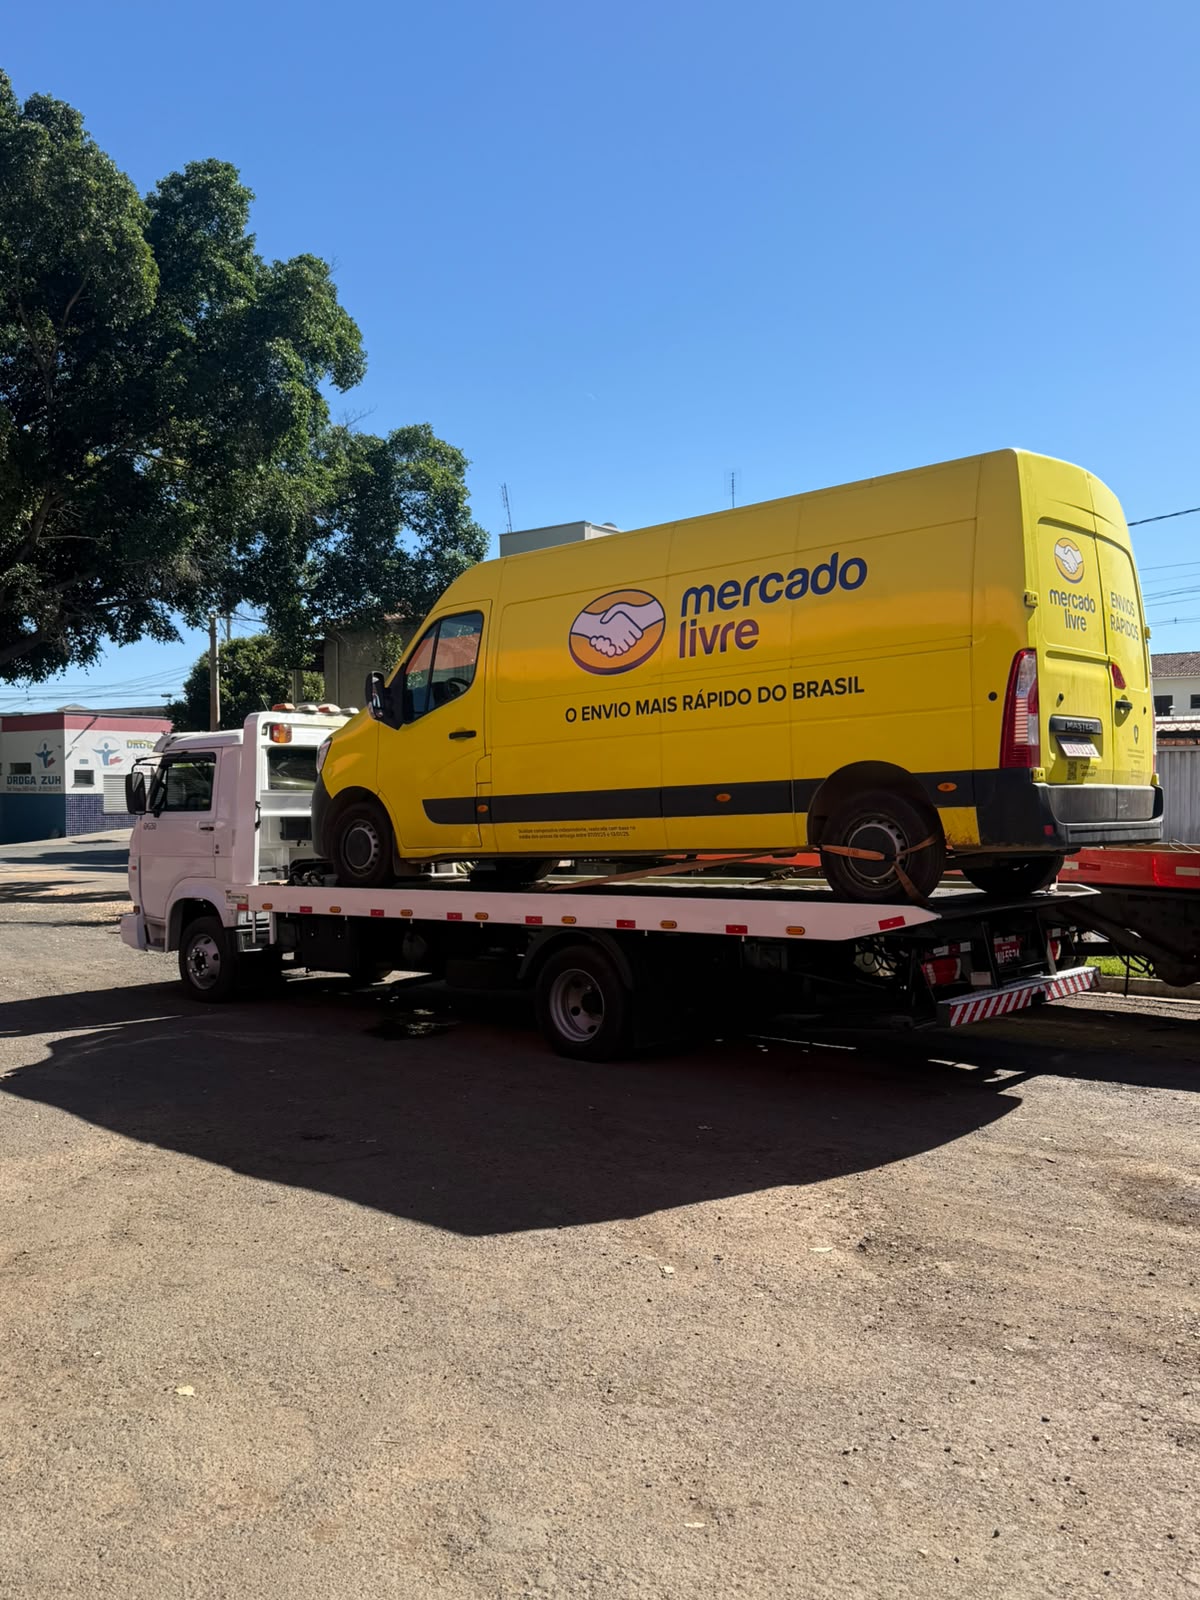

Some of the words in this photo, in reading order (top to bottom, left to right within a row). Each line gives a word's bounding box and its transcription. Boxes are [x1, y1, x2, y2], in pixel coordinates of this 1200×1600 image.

[681, 552, 868, 617] mercado
[1049, 589, 1096, 613] mercado
[1110, 591, 1135, 617] ENVIOS
[1064, 608, 1087, 632] livre
[1110, 612, 1139, 640] RÁPIDOS
[679, 619, 759, 659] livre
[565, 708, 577, 723] O
[582, 702, 631, 721] ENVIO
[635, 696, 677, 716] MAIS
[682, 689, 751, 711] RÁPIDO
[757, 684, 787, 704] DO
[793, 676, 865, 700] BRASIL
[1065, 721, 1094, 730] MASTER
[6, 775, 37, 785] DROGA
[40, 775, 62, 785] ZUH
